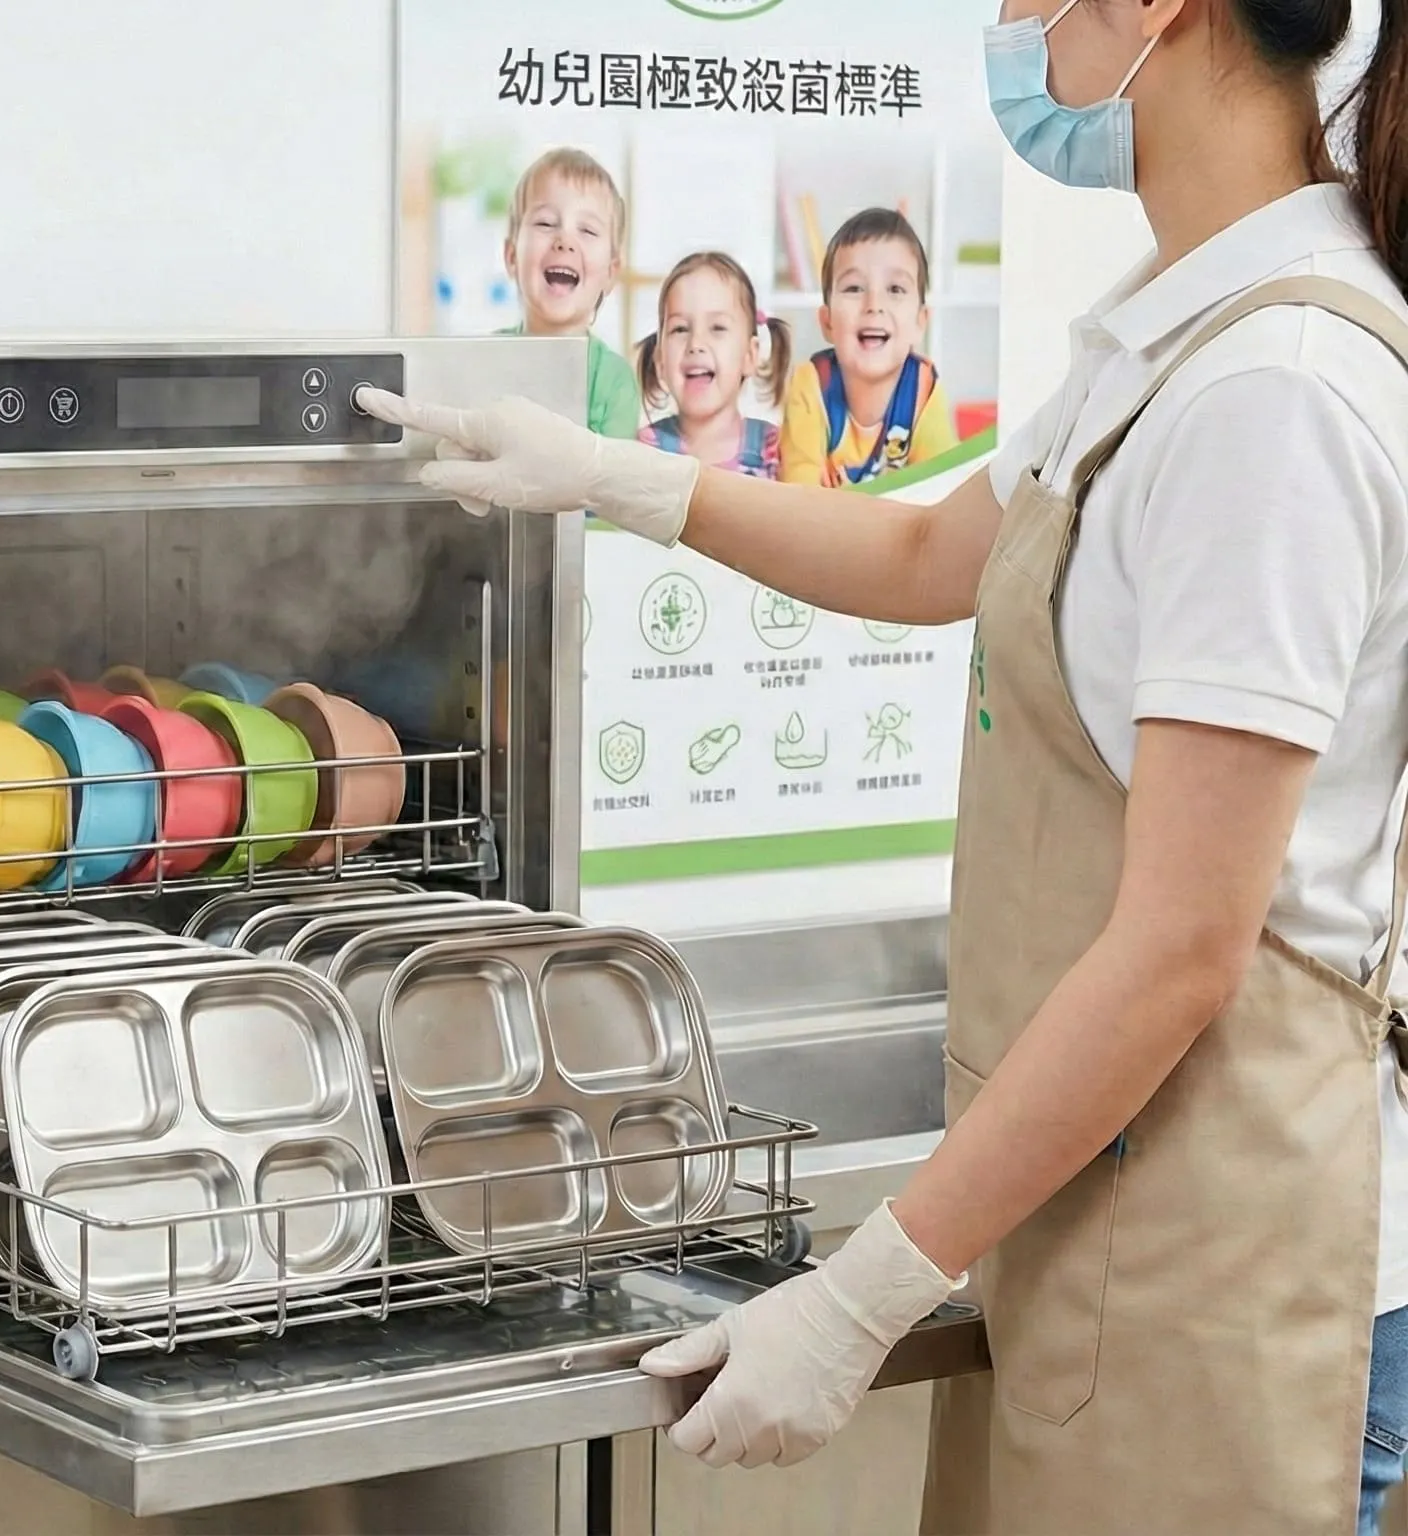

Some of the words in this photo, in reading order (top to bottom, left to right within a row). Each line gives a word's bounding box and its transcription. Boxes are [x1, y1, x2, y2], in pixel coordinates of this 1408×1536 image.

[498, 47, 923, 118] 幼兒園極致殺菌標準
